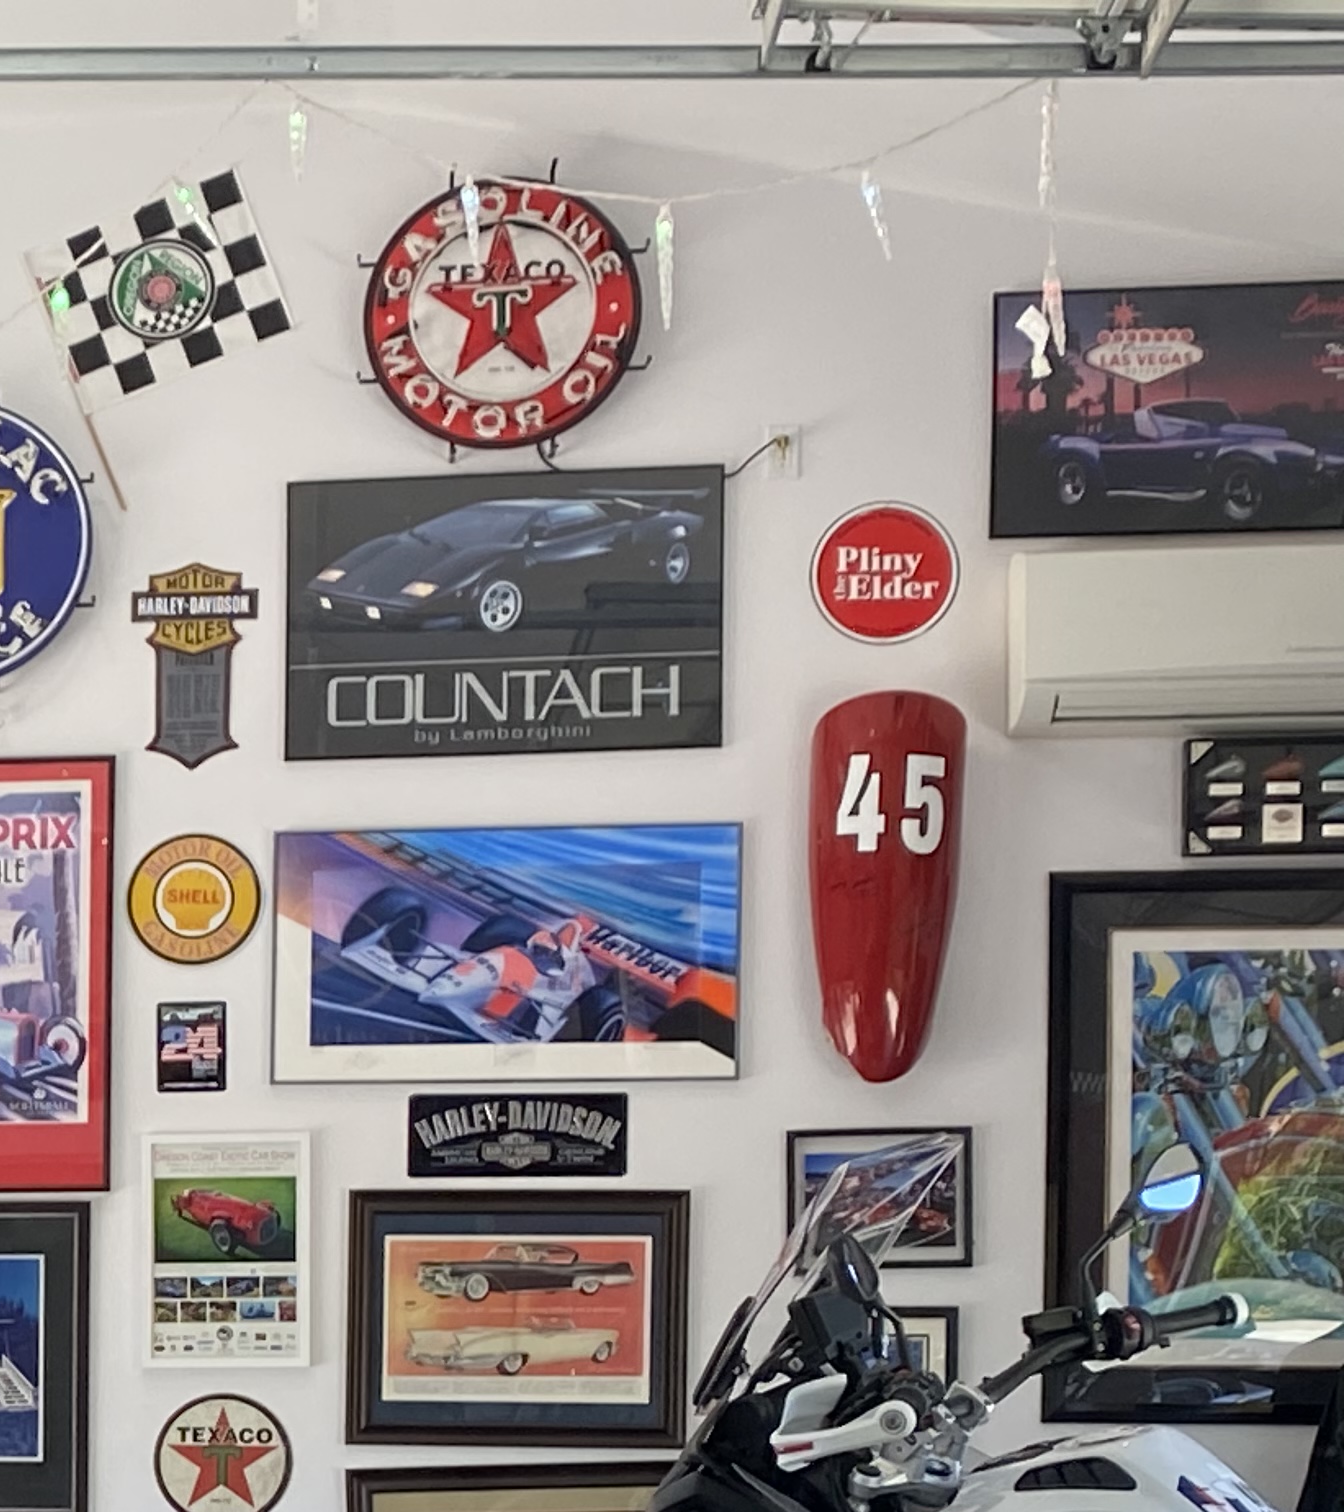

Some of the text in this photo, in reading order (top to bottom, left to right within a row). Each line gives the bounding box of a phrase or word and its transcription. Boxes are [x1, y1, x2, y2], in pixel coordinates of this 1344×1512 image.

[382, 186, 624, 300] GASOLINE
[1100, 349, 1194, 367] LAS VEGAS
[380, 322, 629, 438] MOTOR OIL
[836, 545, 924, 579] Pliny
[166, 569, 226, 590] MOTOR
[847, 574, 940, 601] Elder
[137, 594, 251, 617] HARLEY-DAVIDSON
[162, 620, 227, 646] CYCLES
[327, 664, 680, 727] COUNTACH
[414, 724, 593, 745] by Lamborghini
[835, 752, 947, 856] 45
[146, 840, 244, 879] MOTOR OIL
[167, 889, 220, 905] SHELL
[142, 920, 242, 957] GASOLINE
[414, 1101, 622, 1150] HARLEY-DAVIDSON
[177, 1426, 272, 1444] TEXACO
